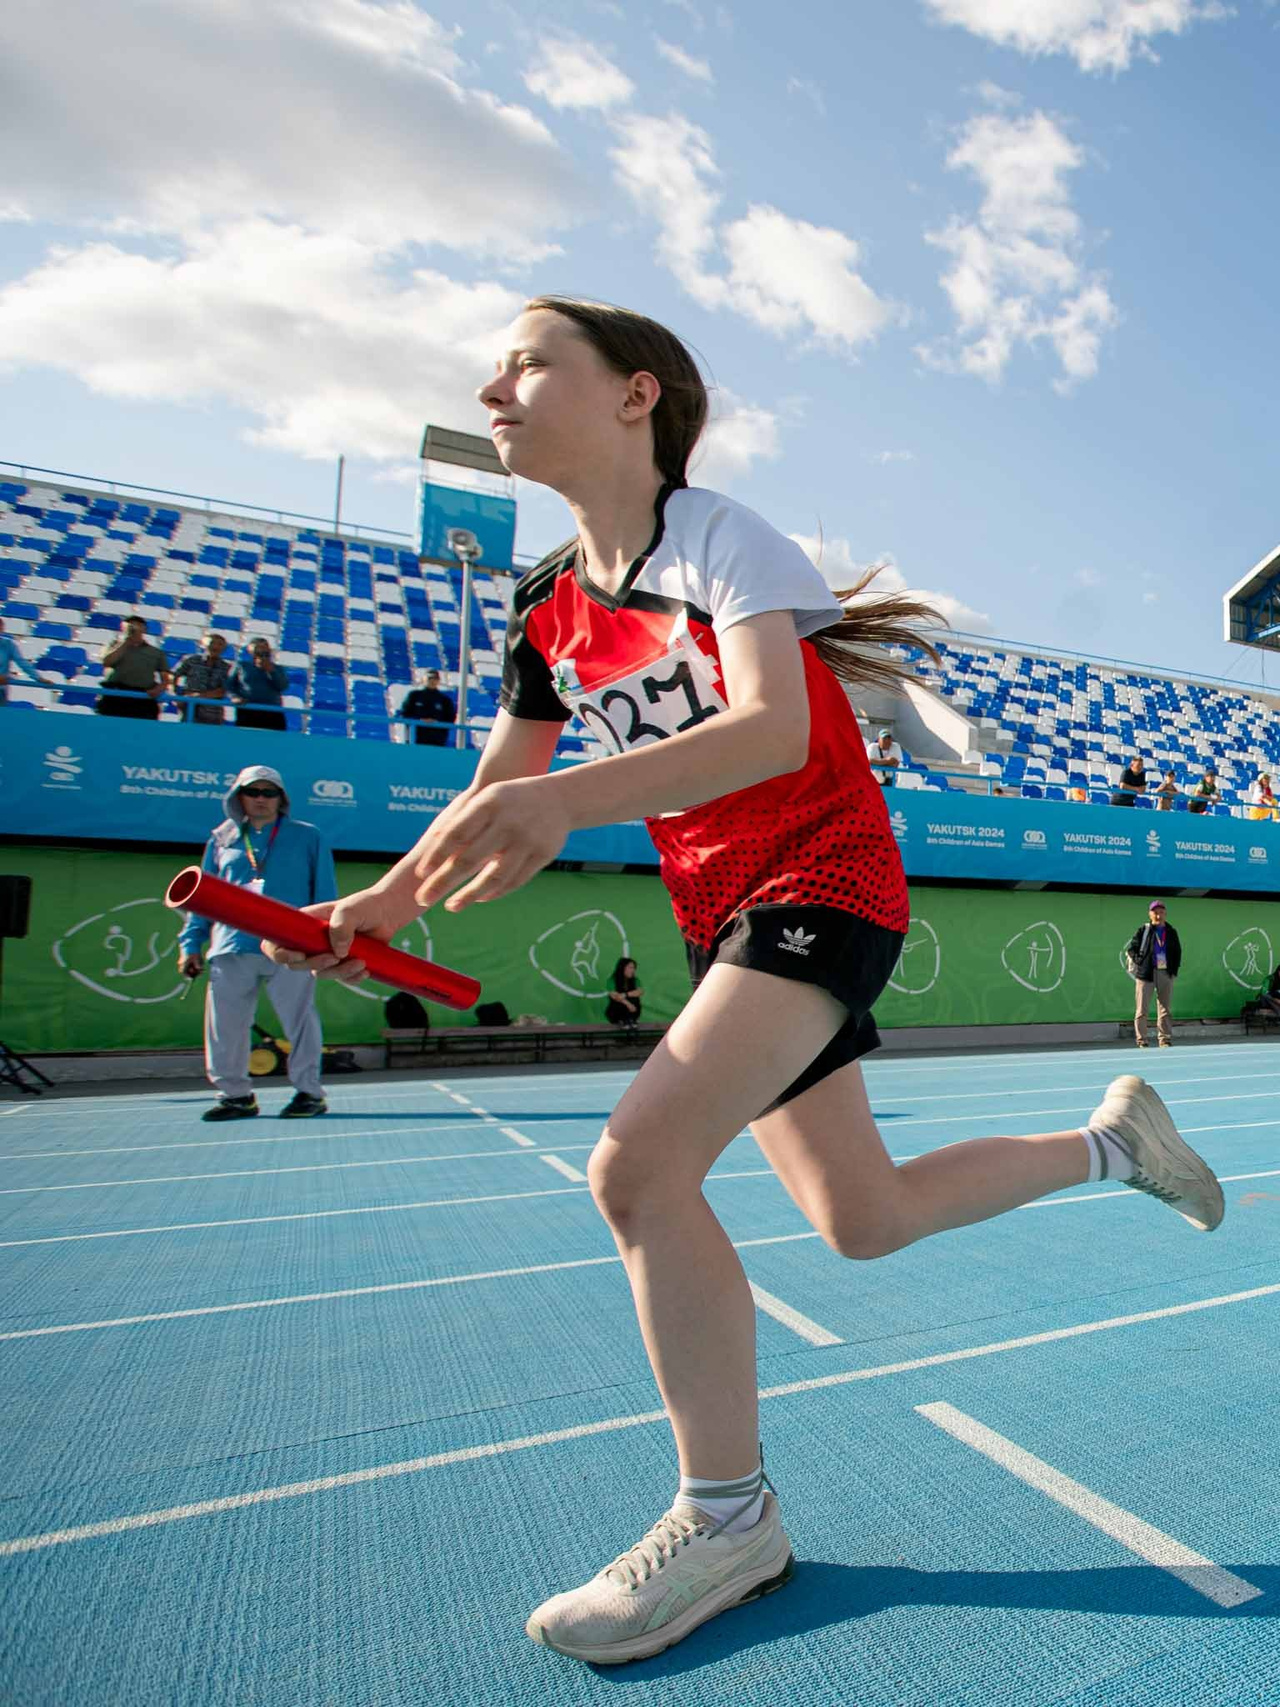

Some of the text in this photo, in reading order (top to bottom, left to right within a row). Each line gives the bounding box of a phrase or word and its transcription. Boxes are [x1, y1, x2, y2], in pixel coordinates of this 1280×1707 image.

[122, 766, 219, 785] YAKUTSK
[389, 784, 463, 801] YAKUTS
[927, 823, 1005, 838] YAKUTSK 2024
[1063, 833, 1131, 847] YAKUTSK 2024
[1175, 841, 1235, 854] YAKUTSK 2024
[777, 942, 810, 956] adidas
